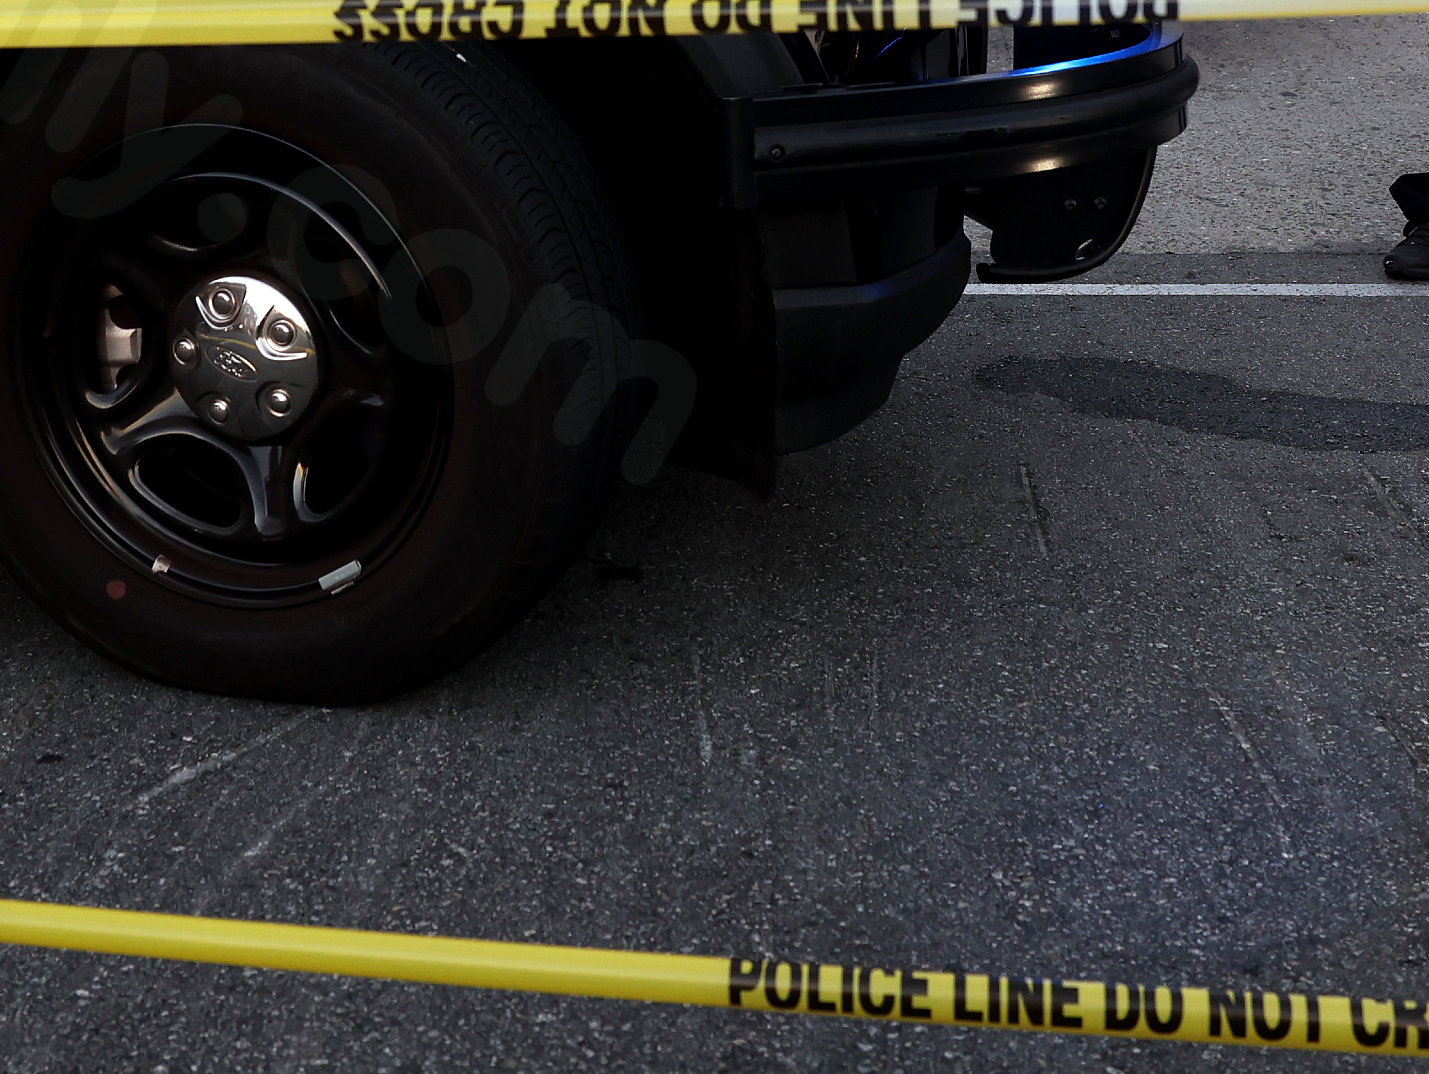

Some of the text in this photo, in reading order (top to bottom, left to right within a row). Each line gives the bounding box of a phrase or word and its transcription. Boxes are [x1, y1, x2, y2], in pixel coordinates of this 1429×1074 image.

[730, 958, 932, 1019] POLICE
[954, 972, 1082, 1028] LINE
[1105, 982, 1184, 1034] DO
[1208, 988, 1322, 1043] NOT
